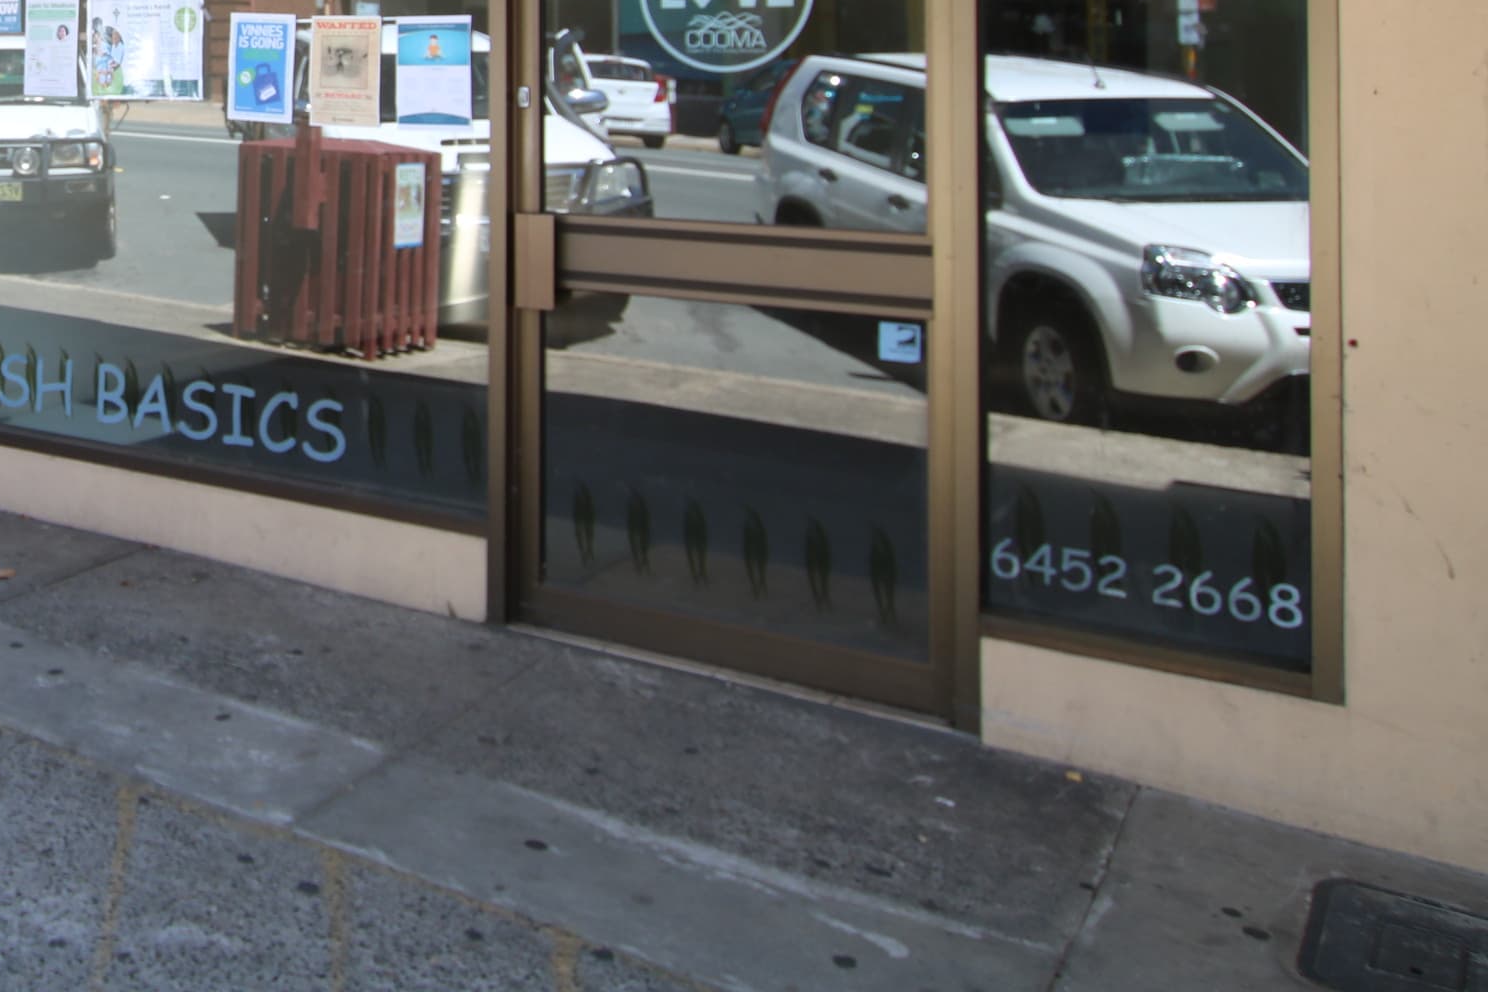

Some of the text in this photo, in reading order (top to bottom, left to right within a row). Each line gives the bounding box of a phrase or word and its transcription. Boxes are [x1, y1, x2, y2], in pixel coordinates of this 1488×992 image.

[240, 24, 284, 37] VINNIES
[316, 22, 378, 30] WANTED
[238, 36, 285, 49] IS GOING
[684, 29, 767, 50] COOMA
[96, 362, 348, 463] BASICS
[990, 537, 1304, 639] 6452 2668
